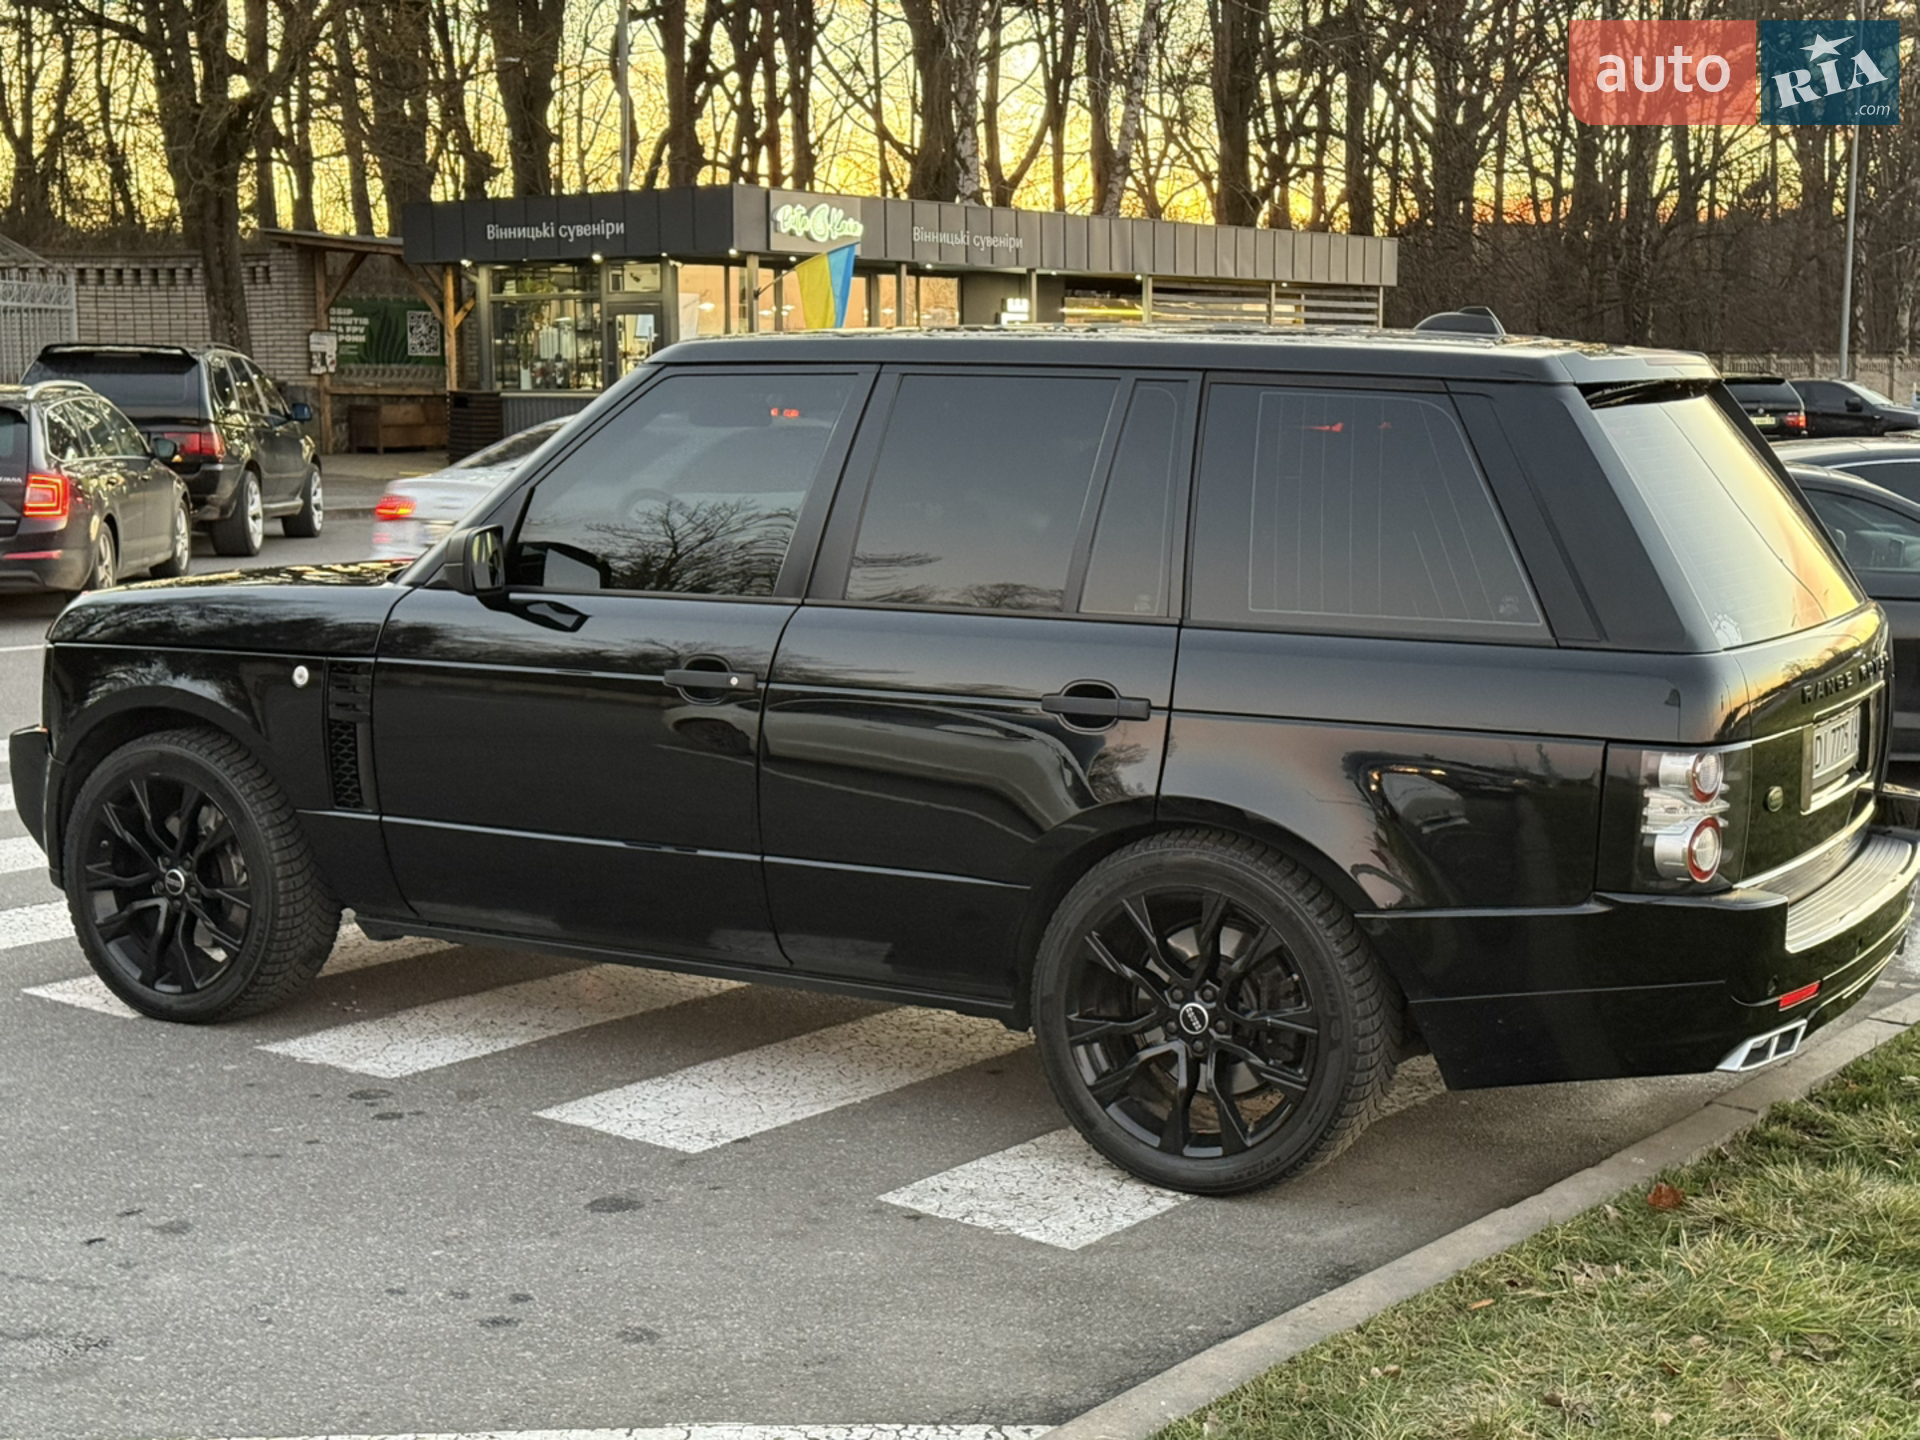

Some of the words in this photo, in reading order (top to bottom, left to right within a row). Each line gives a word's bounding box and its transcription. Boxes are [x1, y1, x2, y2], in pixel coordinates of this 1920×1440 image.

[486, 222, 555, 241] Вінницькі
[558, 219, 625, 243] сувеніри
[913, 226, 970, 247] Вінницькі
[973, 233, 1024, 253] сувеніри
[338, 334, 366, 343] РОНИ
[1801, 671, 1854, 704] RANGE
